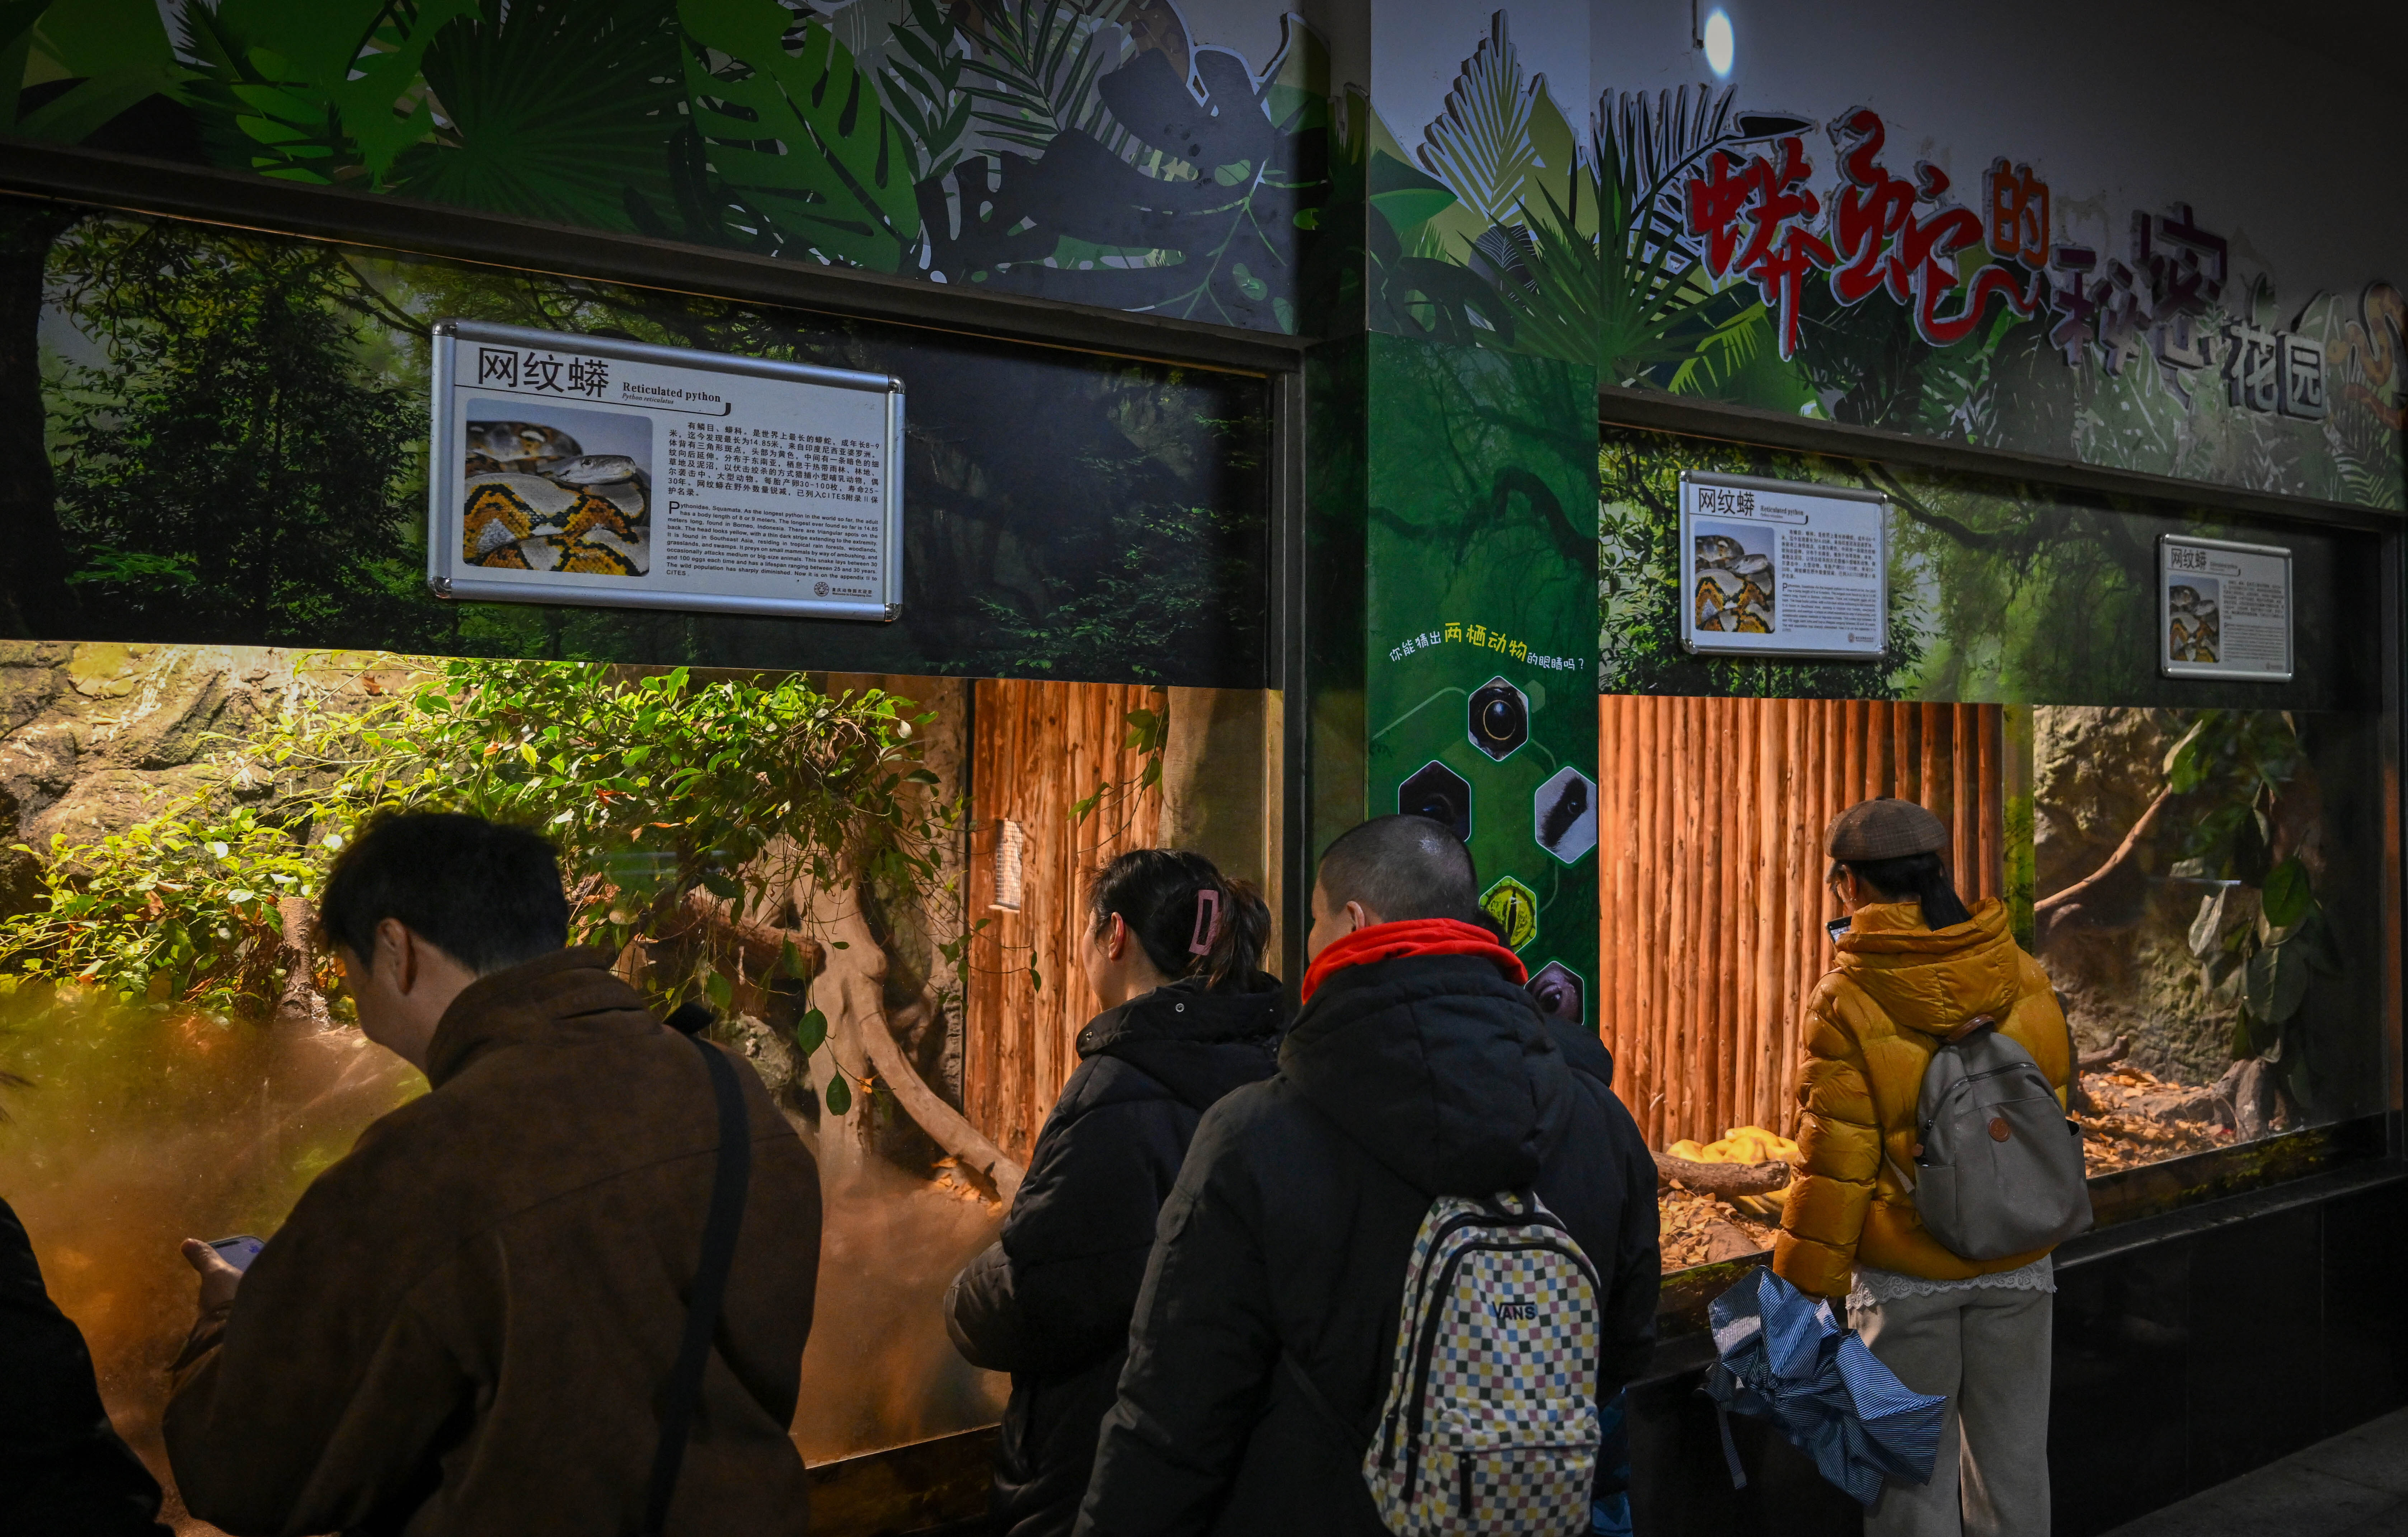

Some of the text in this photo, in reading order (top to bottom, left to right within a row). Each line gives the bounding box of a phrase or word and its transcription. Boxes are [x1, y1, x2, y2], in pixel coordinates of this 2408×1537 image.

[479, 347, 609, 398] 网纹蟒
[623, 382, 720, 402] Reticulated python
[668, 487, 700, 496] 护名录。
[1699, 488, 1754, 516] 网纹蟒
[1760, 505, 1787, 514] Reticulated
[667, 547, 703, 555] occasionally
[1492, 1301, 1535, 1319] VANS
